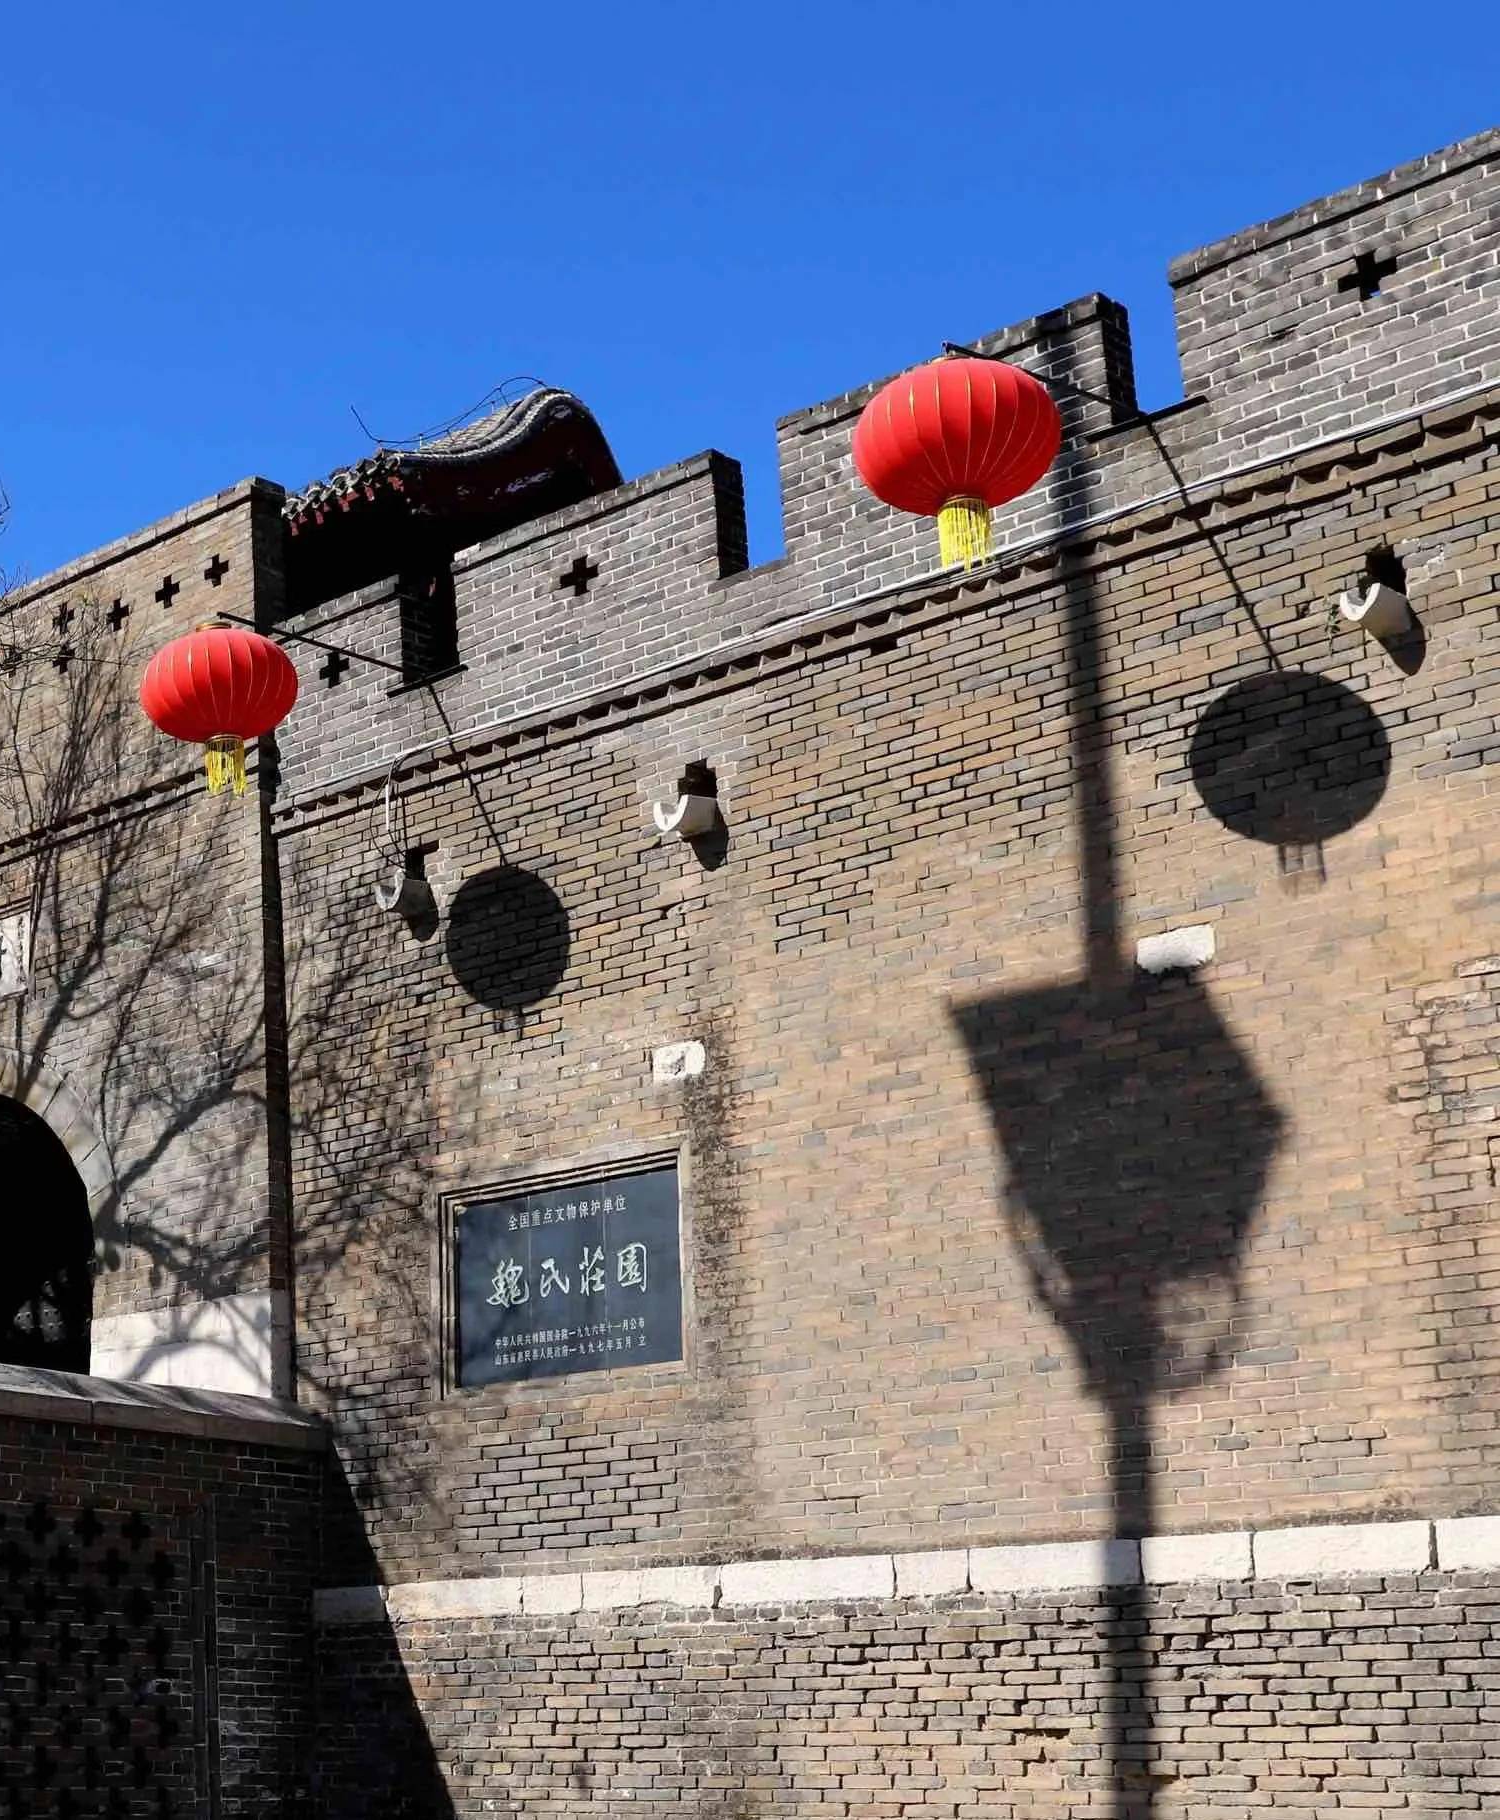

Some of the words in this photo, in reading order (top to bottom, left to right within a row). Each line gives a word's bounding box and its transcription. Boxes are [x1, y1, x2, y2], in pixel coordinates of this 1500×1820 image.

[507, 1194, 628, 1231] 全国重点文物保护单位
